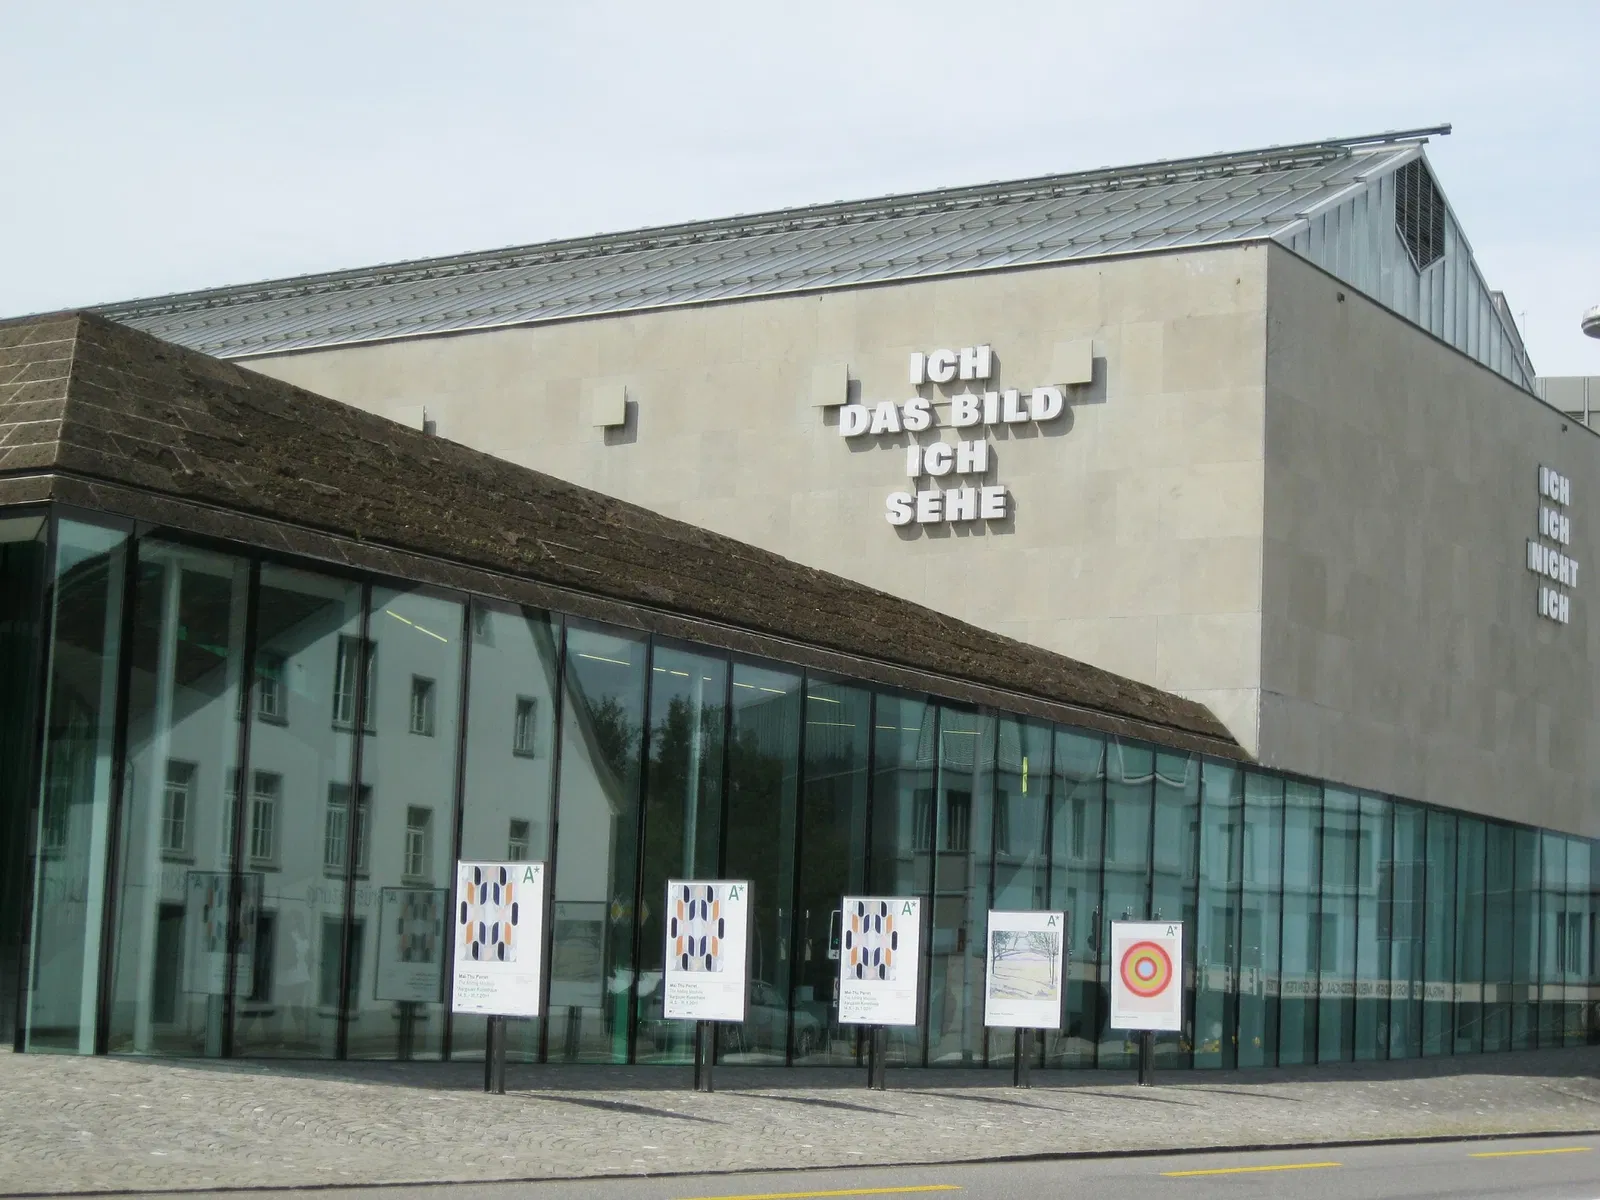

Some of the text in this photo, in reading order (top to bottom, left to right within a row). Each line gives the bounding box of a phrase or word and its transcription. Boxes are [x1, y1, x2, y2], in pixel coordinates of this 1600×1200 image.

[908, 345, 993, 385] ICH
[838, 386, 1065, 438] DAS BILD
[906, 439, 989, 477] ICH
[884, 484, 1008, 526] SEHE
[1539, 466, 1570, 507] ICH
[1539, 506, 1570, 546] ICH
[1527, 541, 1579, 589] NICHT
[1537, 586, 1569, 624] ICH
